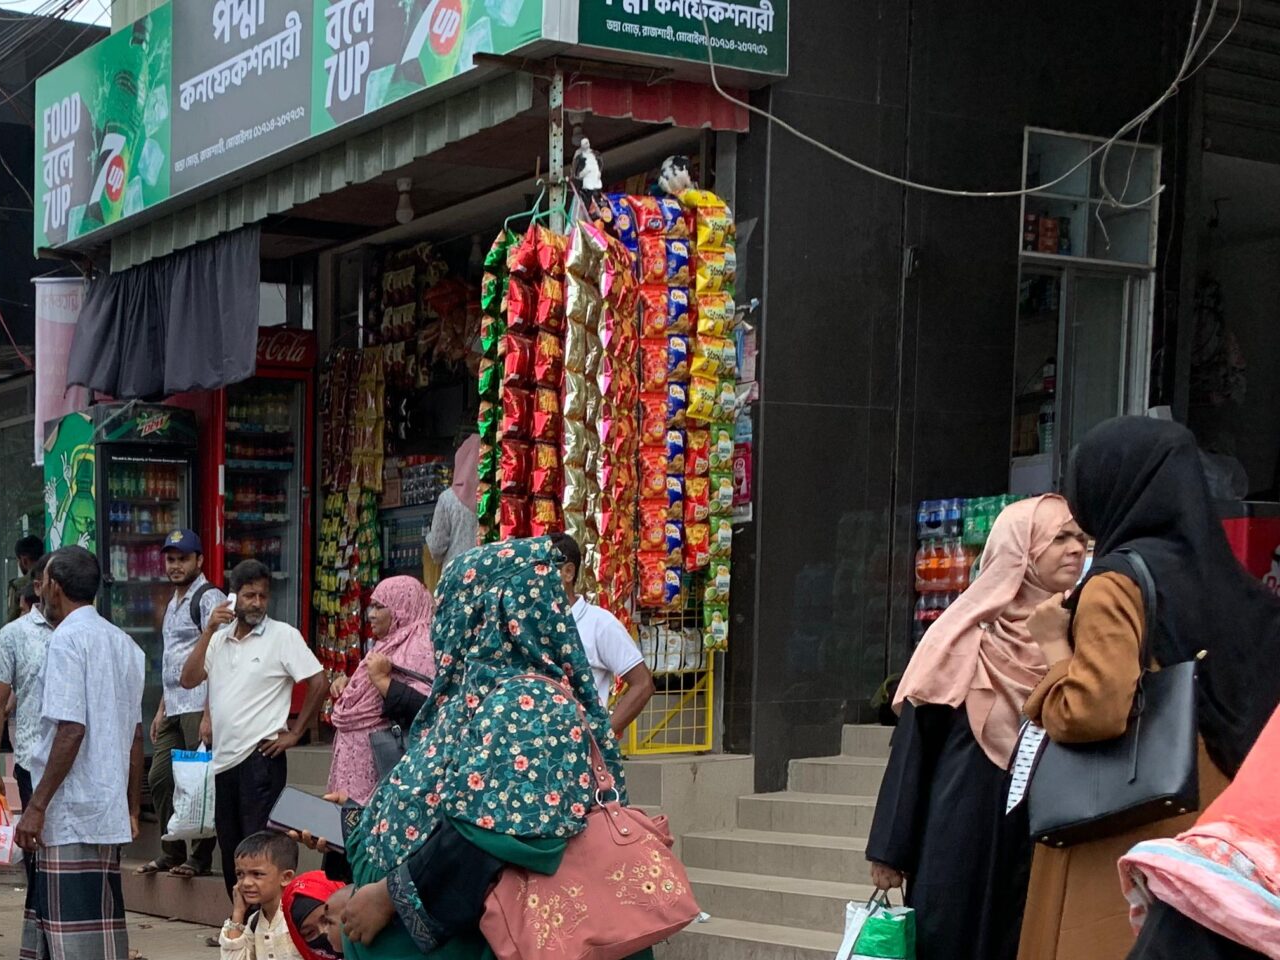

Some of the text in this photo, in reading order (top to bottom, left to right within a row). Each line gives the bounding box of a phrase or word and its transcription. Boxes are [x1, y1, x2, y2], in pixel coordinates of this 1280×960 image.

[180, 10, 302, 111] কনফেকশনারী
[324, 41, 370, 108] 7UP
[44, 92, 80, 148] FOOD
[43, 140, 74, 188] বলে
[43, 184, 71, 233] 7UP
